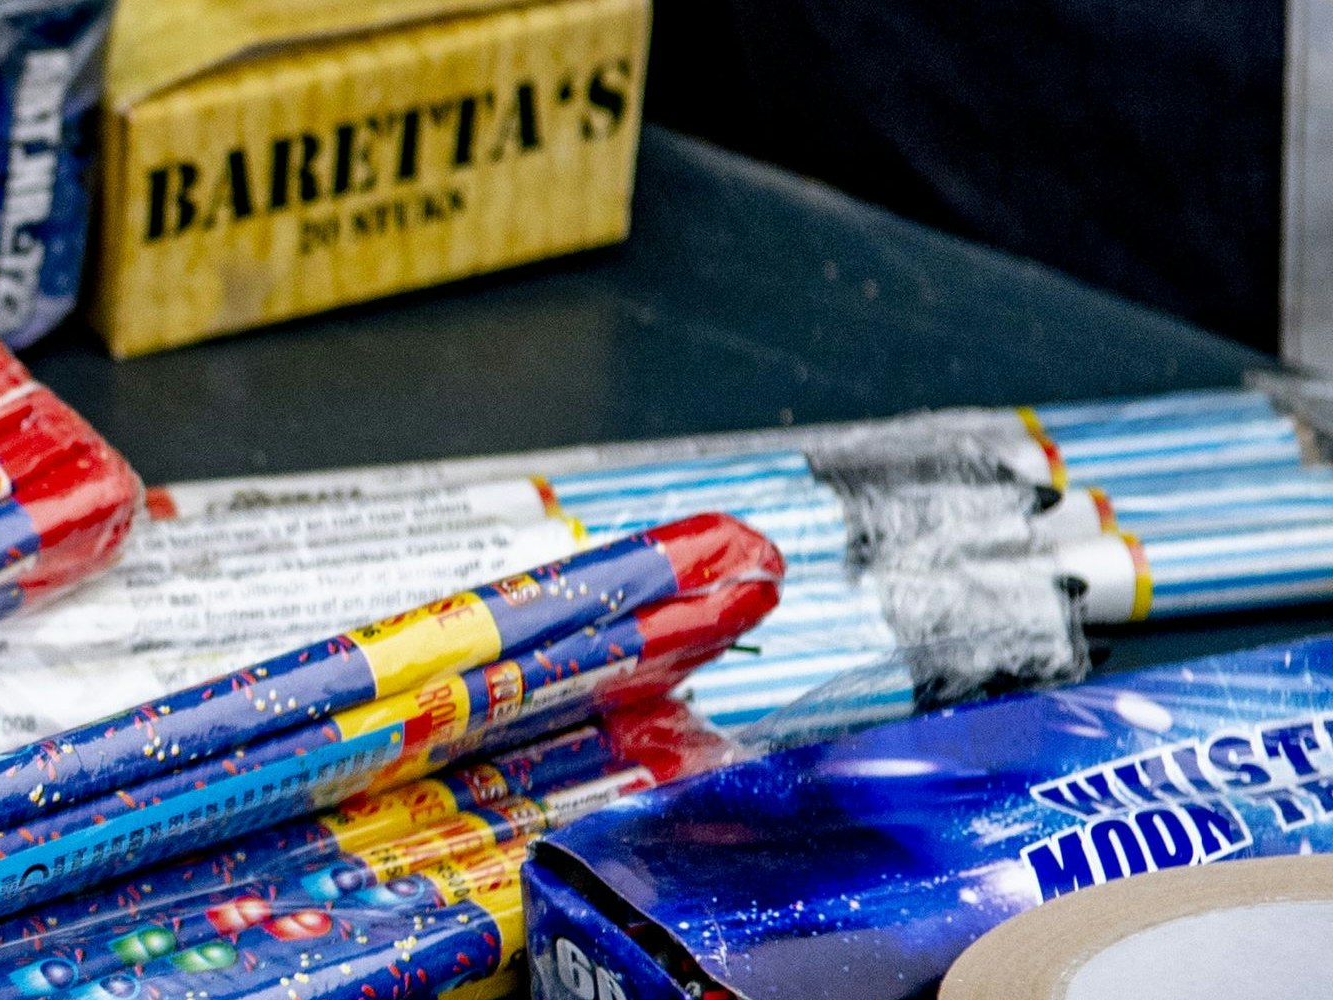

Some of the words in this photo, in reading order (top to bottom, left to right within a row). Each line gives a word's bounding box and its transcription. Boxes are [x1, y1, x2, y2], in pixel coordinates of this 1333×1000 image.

[350, 189, 465, 242] STUKS
[1030, 712, 1333, 824] WHIST
[1020, 800, 1254, 906] MOON
